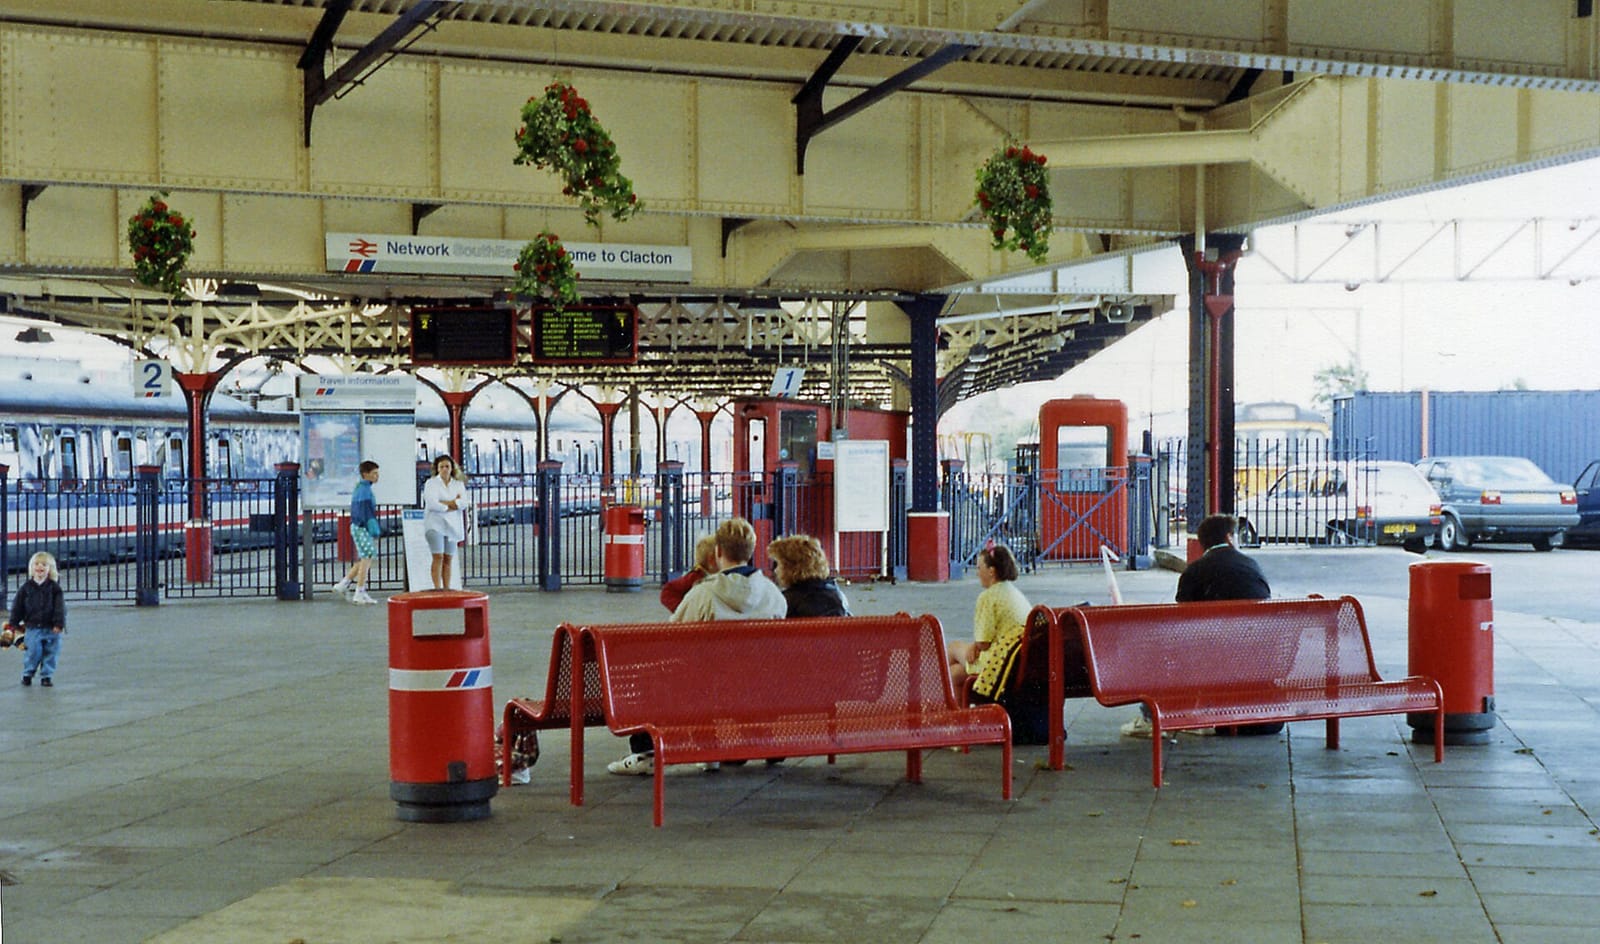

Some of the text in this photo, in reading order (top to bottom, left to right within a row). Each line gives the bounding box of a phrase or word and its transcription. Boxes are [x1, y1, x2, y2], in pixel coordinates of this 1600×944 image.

[387, 241, 450, 256] Network
[602, 250, 616, 263] to
[620, 250, 673, 265] Clacton
[421, 319, 429, 329] 2
[143, 362, 162, 389] 2
[785, 370, 795, 390] 1
